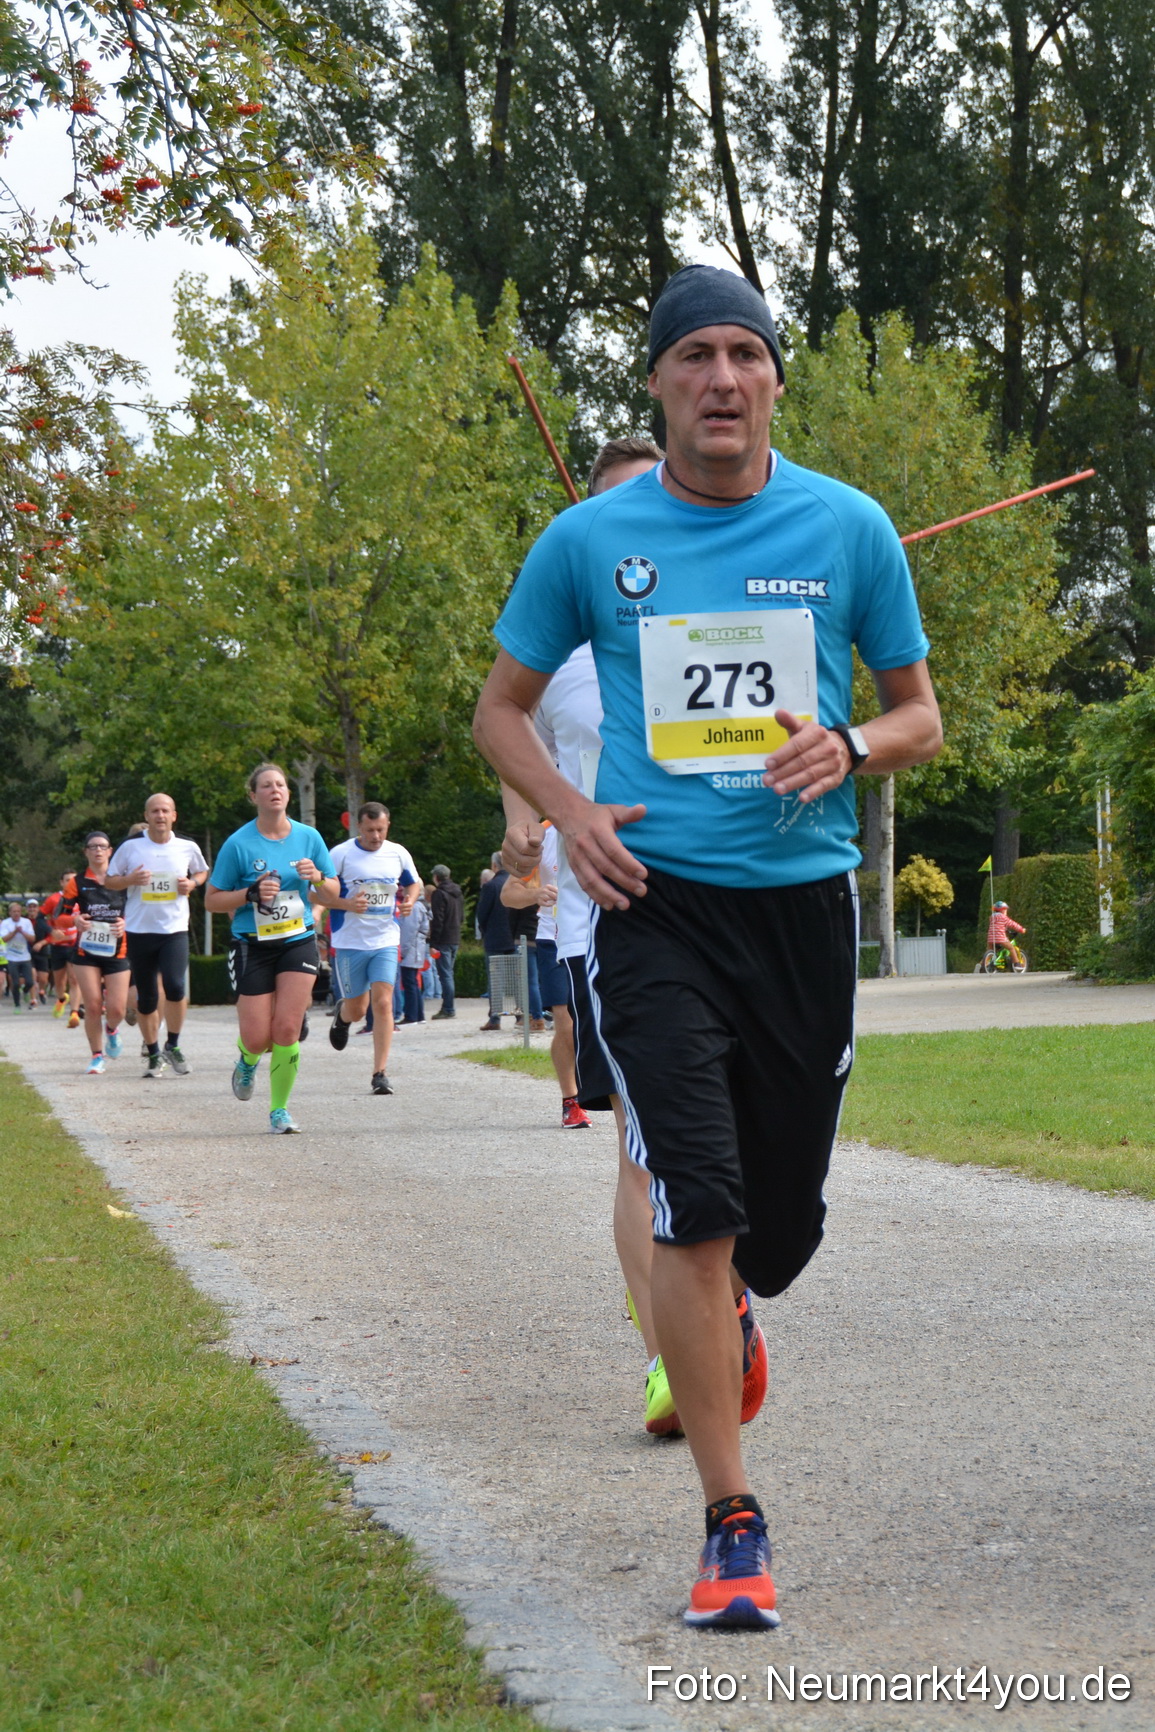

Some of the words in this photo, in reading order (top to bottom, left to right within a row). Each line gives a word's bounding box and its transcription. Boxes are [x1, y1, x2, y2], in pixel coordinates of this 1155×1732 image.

[618, 557, 655, 572] BMW
[746, 579, 829, 597] BOCK
[616, 605, 658, 619] PARTL
[617, 619, 639, 627] Neum
[705, 626, 764, 641] BOCK
[683, 661, 775, 711] 273
[654, 708, 661, 717] D
[703, 727, 765, 745] Johann
[711, 772, 765, 789] Stadtl
[150, 881, 170, 891] 145
[364, 893, 389, 905] 2307
[272, 906, 290, 921] 52
[86, 931, 110, 943] 2181
